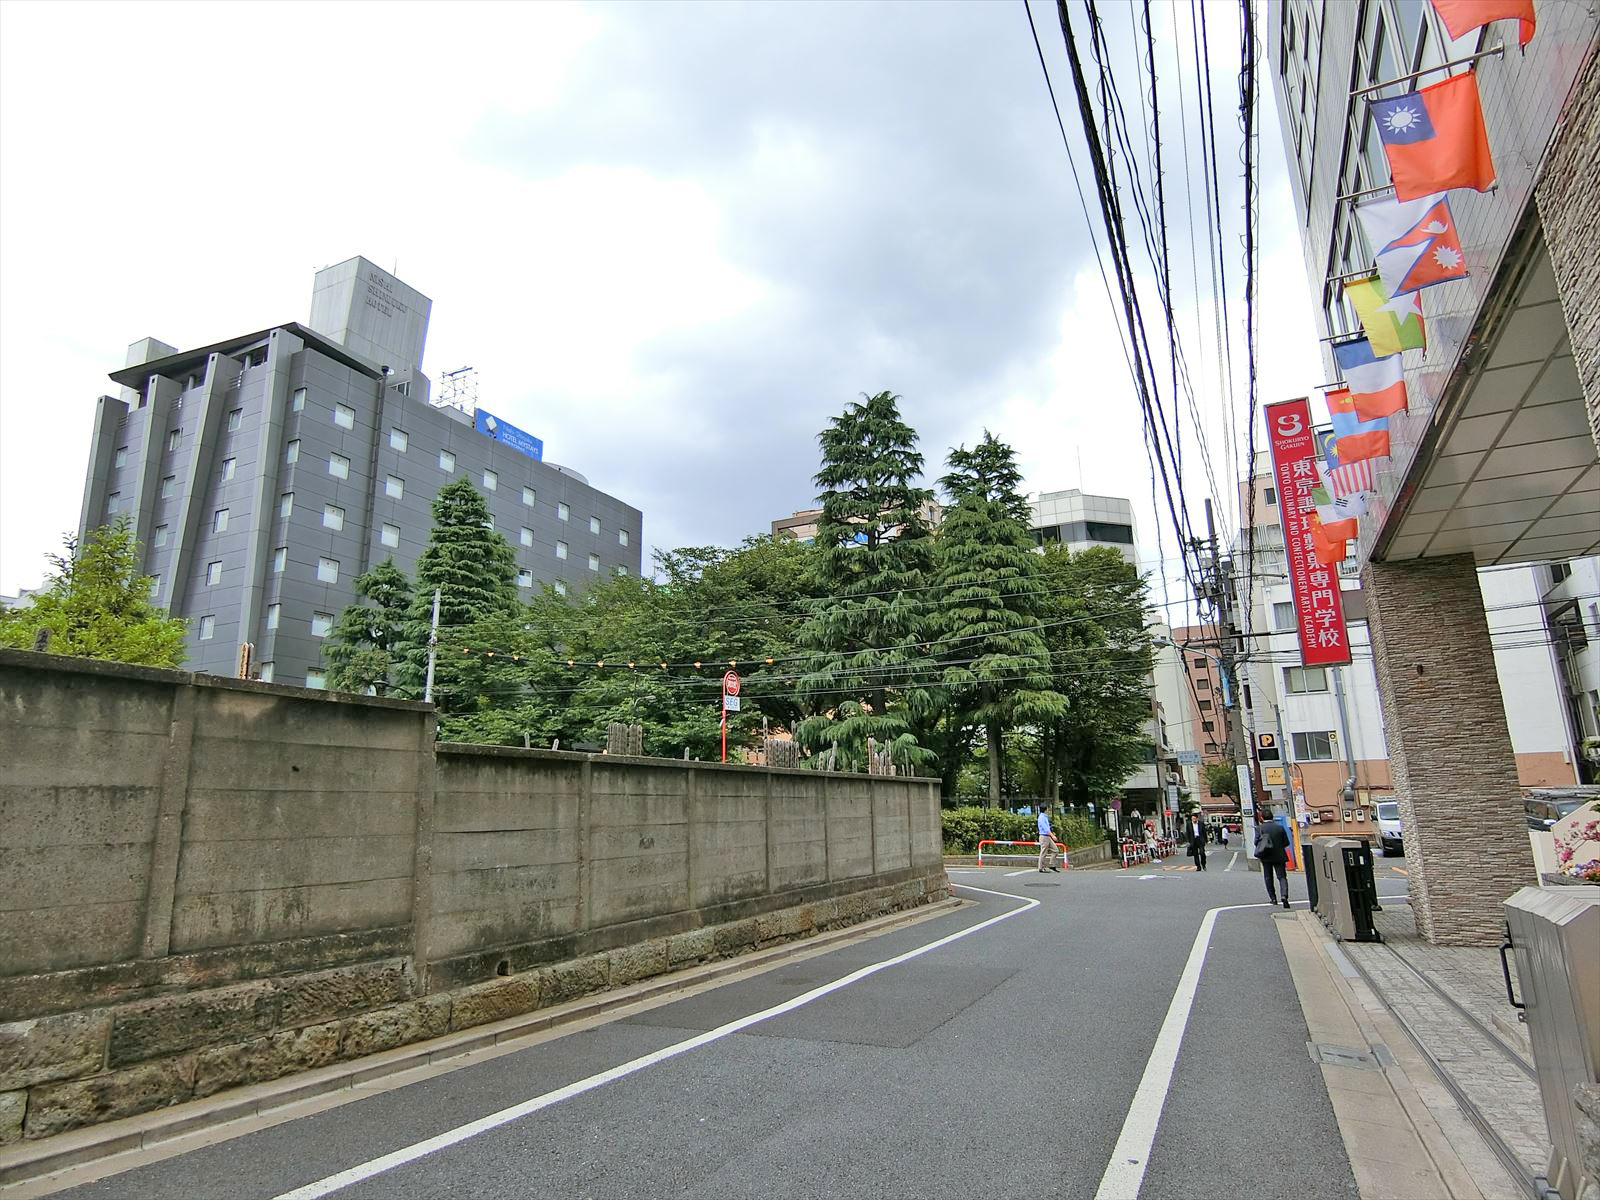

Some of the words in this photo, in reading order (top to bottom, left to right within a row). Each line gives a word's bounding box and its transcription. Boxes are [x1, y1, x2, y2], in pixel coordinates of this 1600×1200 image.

[1280, 462, 1291, 485] TOKYO
[1284, 486, 1296, 519] CULINARY
[1289, 521, 1299, 536] AND
[1301, 596, 1311, 613] ARTS
[1303, 615, 1317, 649] ACADEMY
